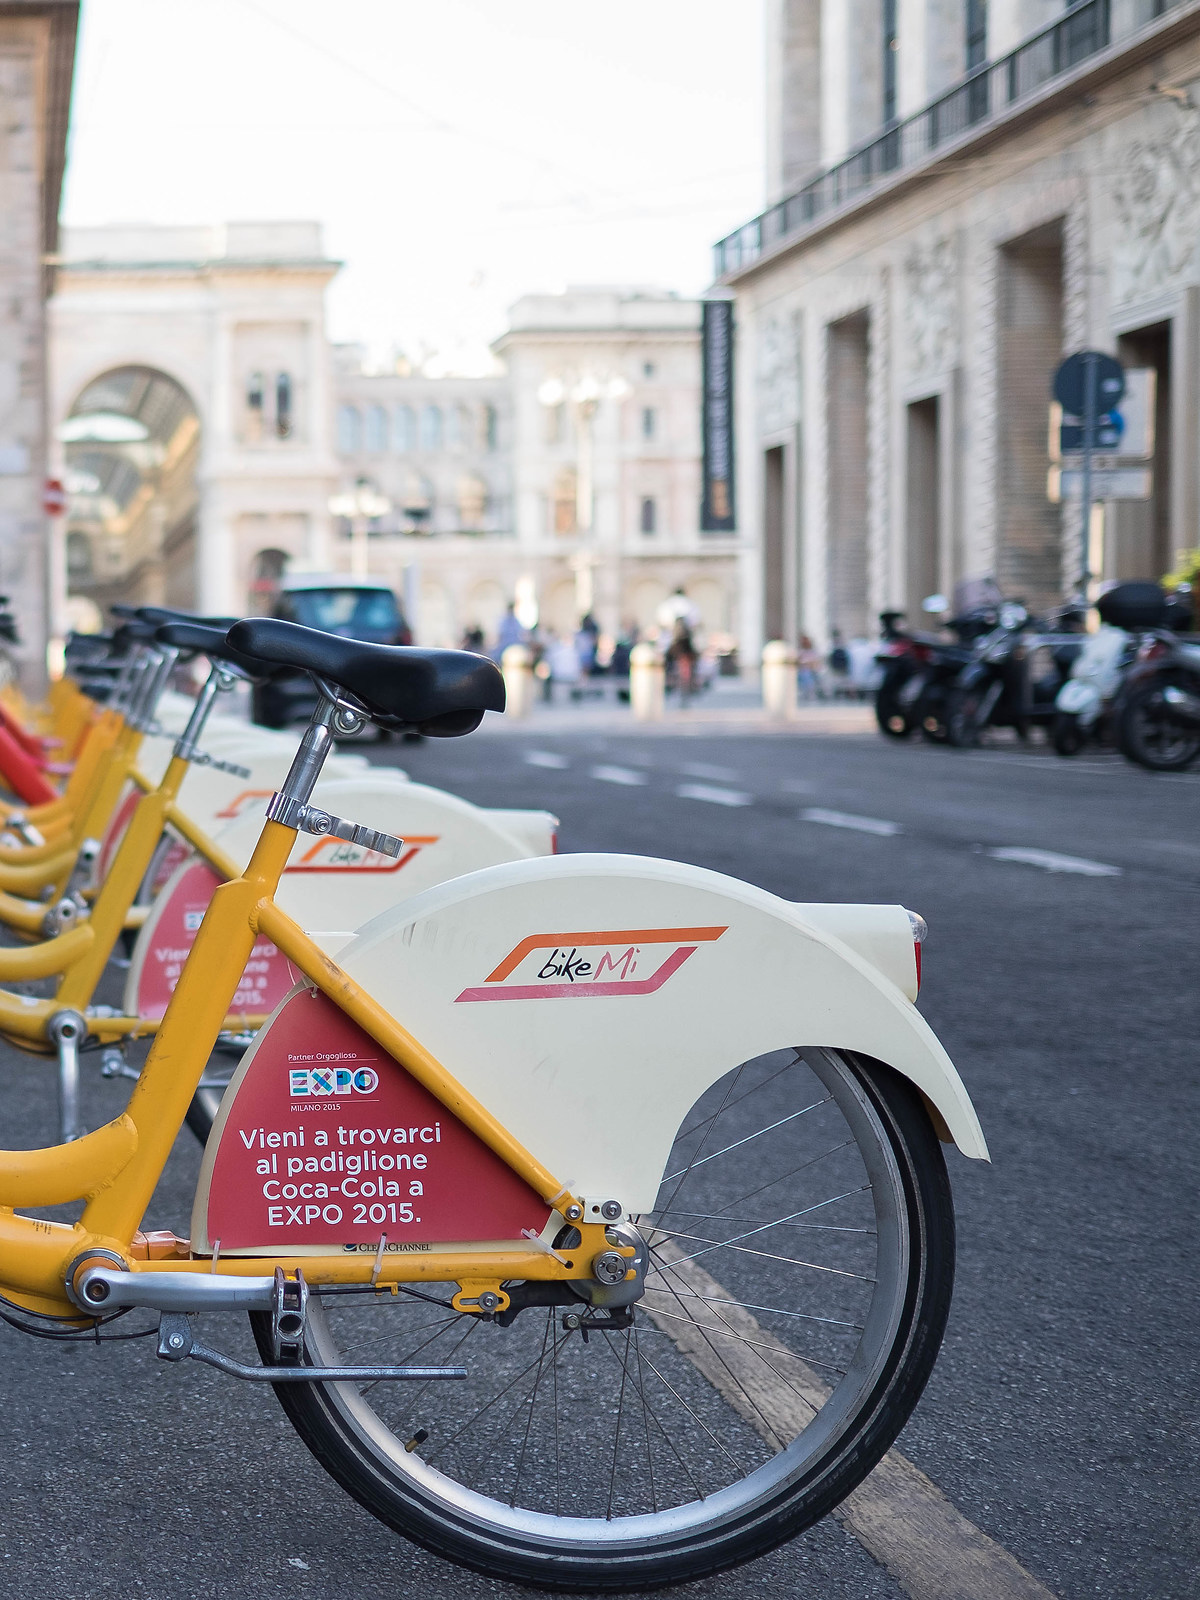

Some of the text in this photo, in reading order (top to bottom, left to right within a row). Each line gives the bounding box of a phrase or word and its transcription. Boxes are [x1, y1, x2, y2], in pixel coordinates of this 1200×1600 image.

[536, 947, 641, 983] bikeMi
[288, 1052, 357, 1061] Partner Orgoglioso
[289, 1066, 379, 1097] EXPO
[290, 1103, 341, 1112] MILANO 2015
[239, 1122, 442, 1150] Vieni a trovarci
[256, 1150, 428, 1178] al padiglione
[262, 1176, 424, 1201] Coca-Cola a
[268, 1202, 422, 1227] EXPO 2015.
